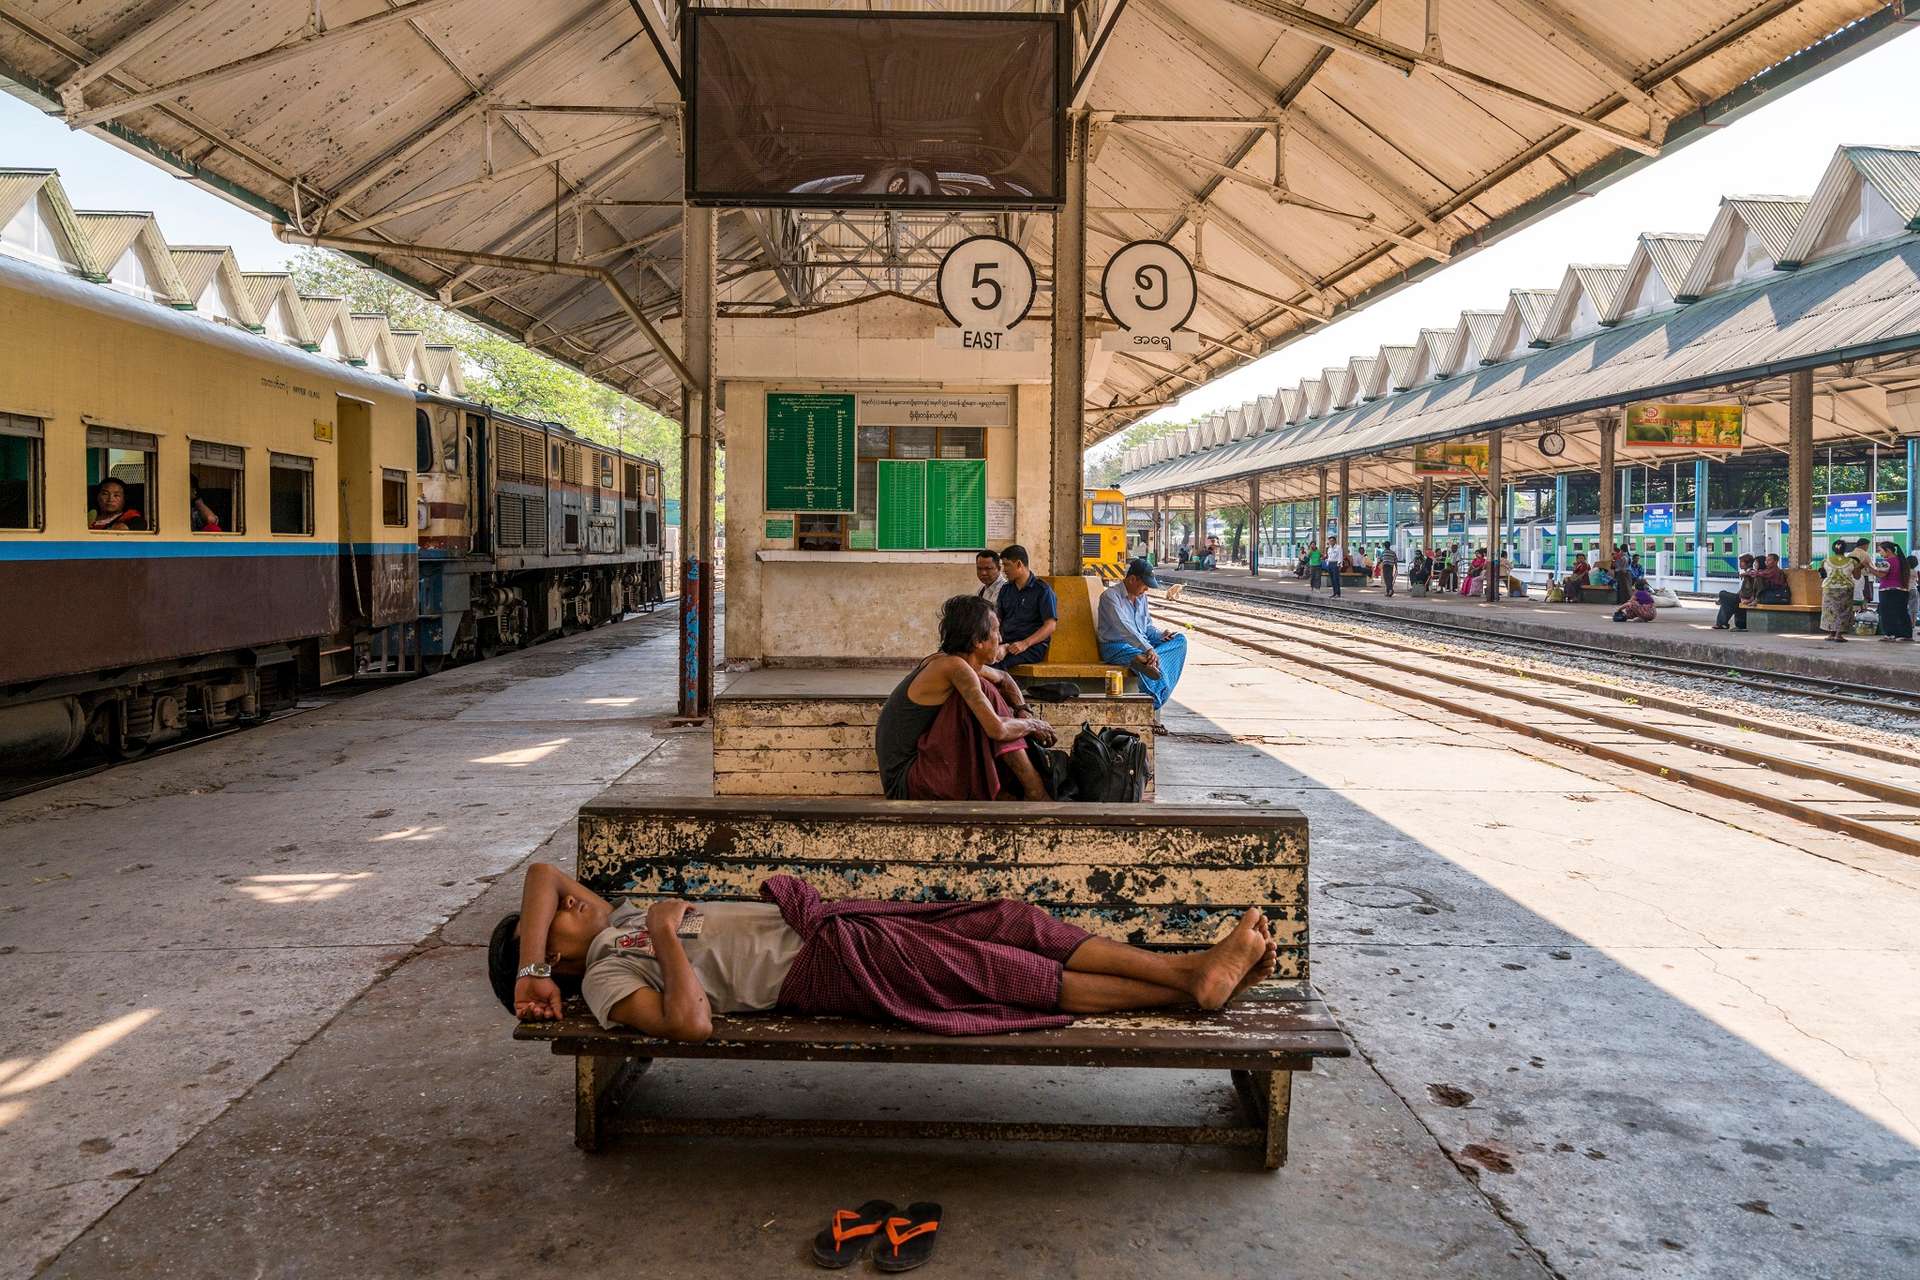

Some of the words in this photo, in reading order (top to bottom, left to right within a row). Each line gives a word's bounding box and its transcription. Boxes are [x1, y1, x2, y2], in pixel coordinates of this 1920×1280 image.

[971, 262, 1002, 311] 5
[1134, 264, 1168, 311] ၅
[963, 331, 1003, 350] EAST
